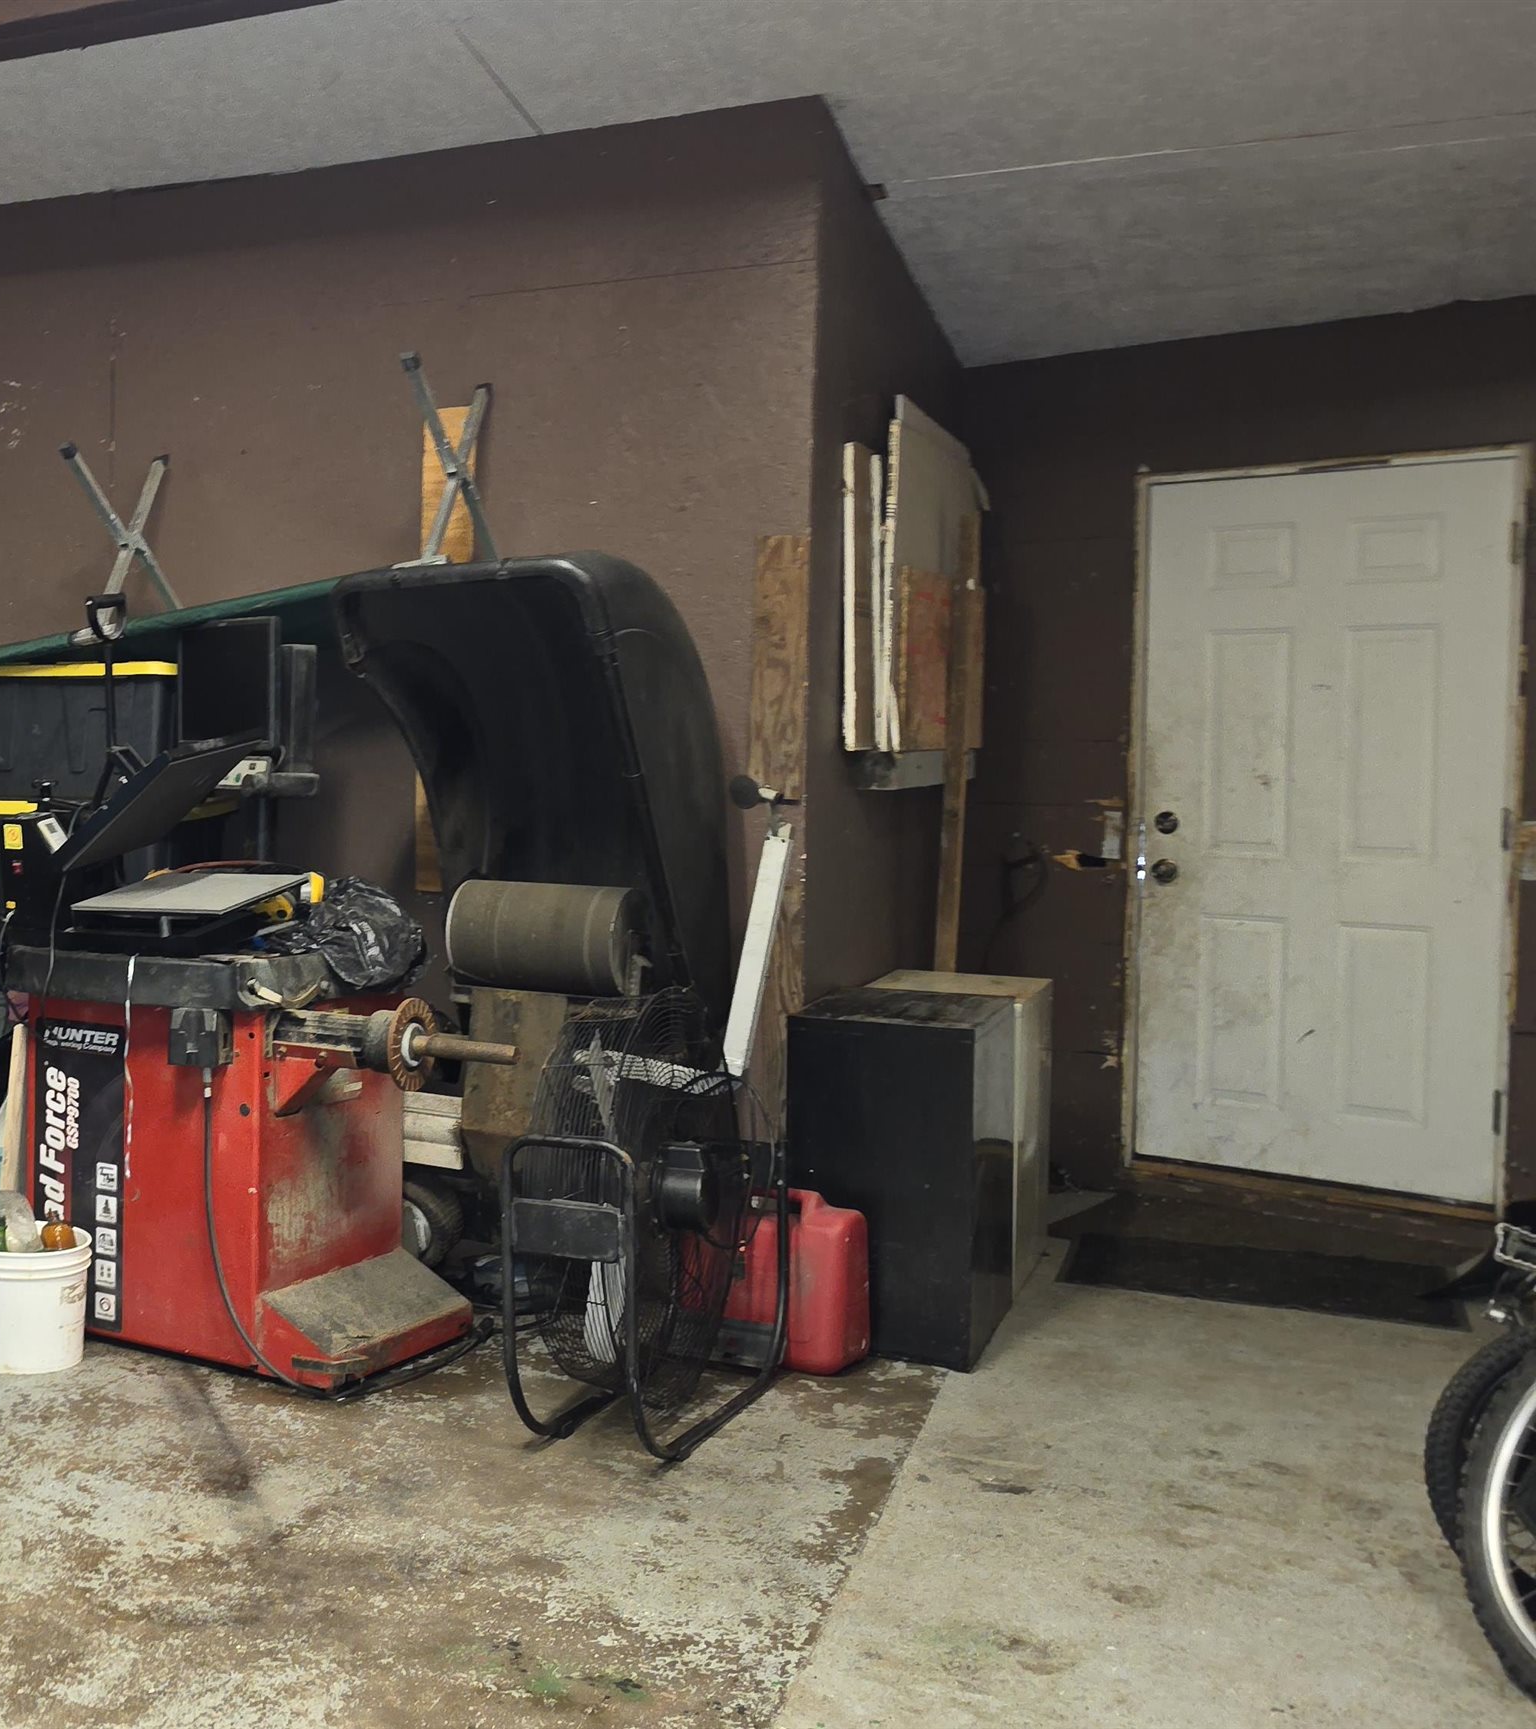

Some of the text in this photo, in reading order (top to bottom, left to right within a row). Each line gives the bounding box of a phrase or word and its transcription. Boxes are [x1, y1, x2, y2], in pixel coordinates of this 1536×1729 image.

[39, 1066, 67, 1221] ad Force
[66, 1077, 80, 1150] GSP9700
